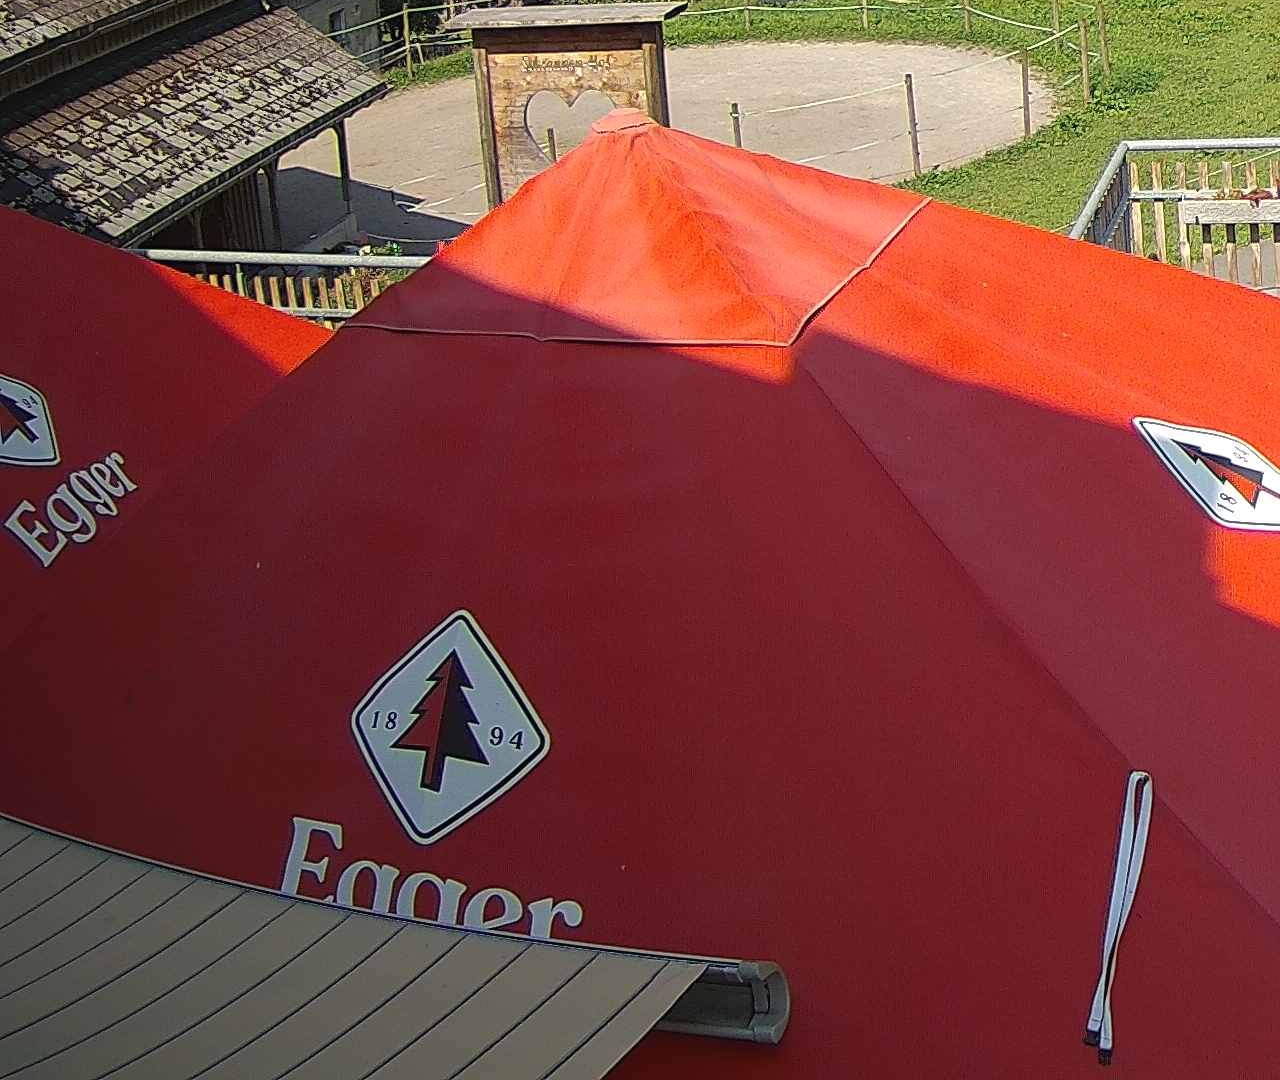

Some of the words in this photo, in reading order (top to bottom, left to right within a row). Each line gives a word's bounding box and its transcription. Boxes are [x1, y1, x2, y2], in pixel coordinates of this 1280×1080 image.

[4, 452, 138, 567] Egger
[371, 710, 398, 730] 18
[489, 726, 524, 750] 94
